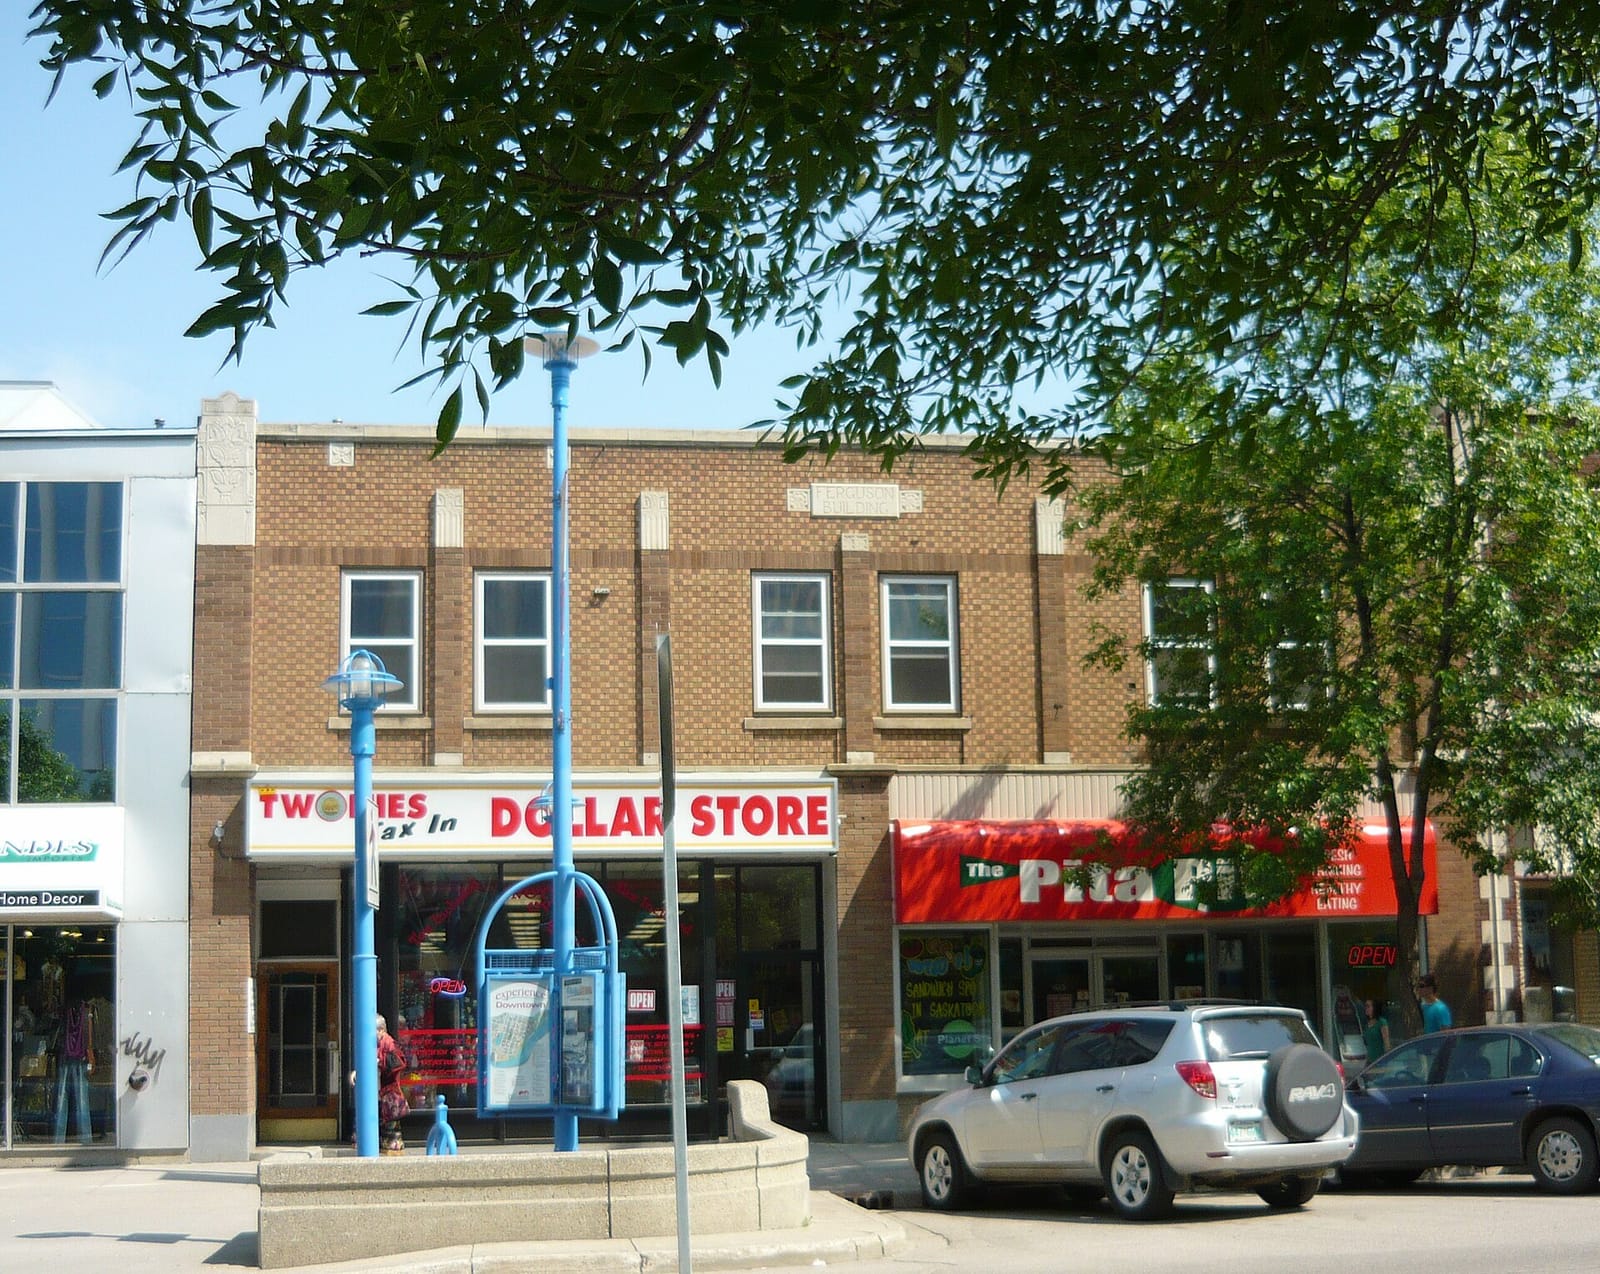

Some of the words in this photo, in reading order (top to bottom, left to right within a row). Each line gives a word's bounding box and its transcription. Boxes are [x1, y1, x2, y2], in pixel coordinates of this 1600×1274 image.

[816, 486, 895, 499] FERGUSON
[823, 501, 888, 514] BUILDING
[259, 791, 428, 822] TWOIES
[691, 795, 829, 836] STORE
[378, 822, 417, 840] ax
[428, 814, 458, 833] In
[1311, 864, 1362, 877] HINING
[966, 862, 1004, 878] The
[1019, 859, 1154, 903] Pita
[1311, 882, 1362, 895] HEATHY
[42, 892, 84, 904] Decor
[1348, 945, 1397, 966] OPEN
[431, 980, 464, 992] OPEN
[495, 1001, 547, 1009] Downtown
[630, 992, 654, 1008] OPEN
[1288, 1083, 1336, 1102] RAV4
